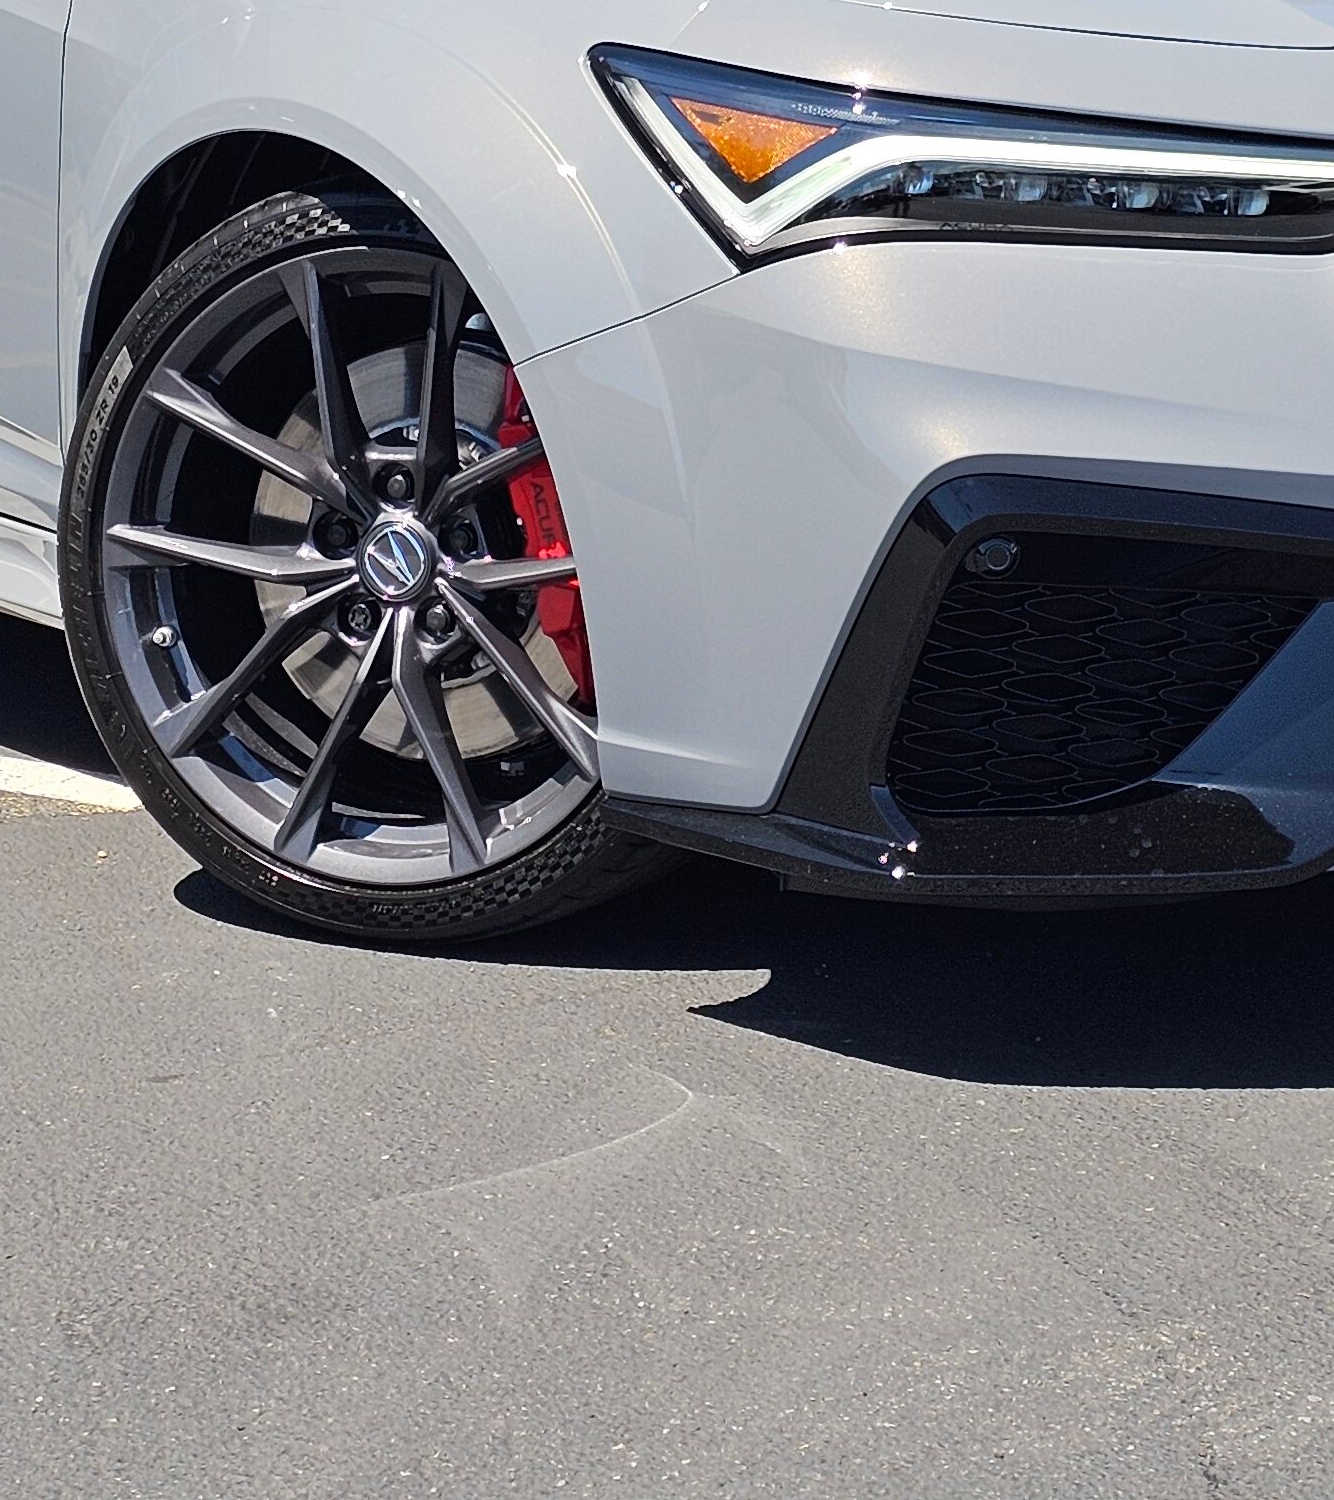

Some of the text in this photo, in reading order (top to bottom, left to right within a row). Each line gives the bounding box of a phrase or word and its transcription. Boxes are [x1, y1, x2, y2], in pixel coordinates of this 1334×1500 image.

[95, 399, 109, 425] ZR
[108, 375, 119, 395] 19
[531, 482, 557, 546] ACUR
